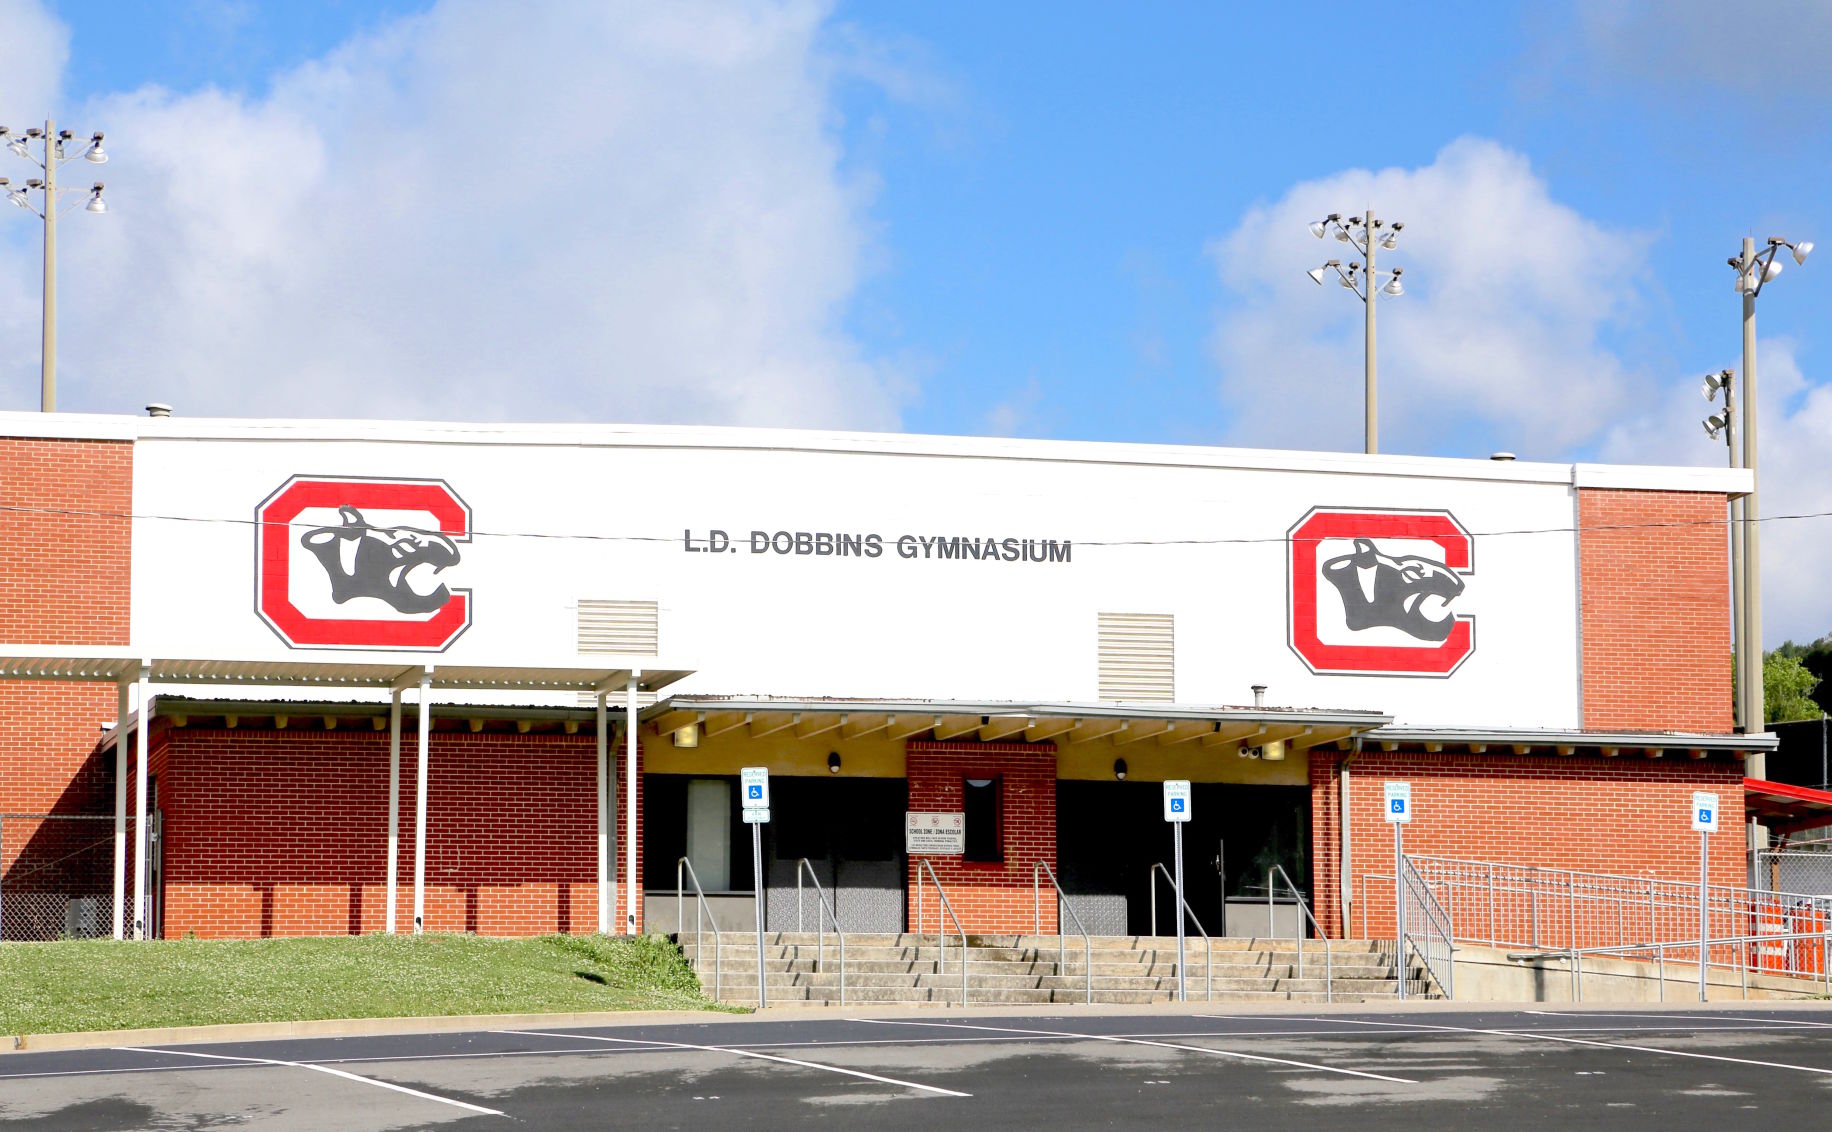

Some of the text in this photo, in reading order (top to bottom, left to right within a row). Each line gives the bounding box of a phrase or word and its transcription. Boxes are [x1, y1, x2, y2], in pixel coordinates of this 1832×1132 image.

[685, 529, 1071, 562] L.D. DOBBINS GYMNASIUM
